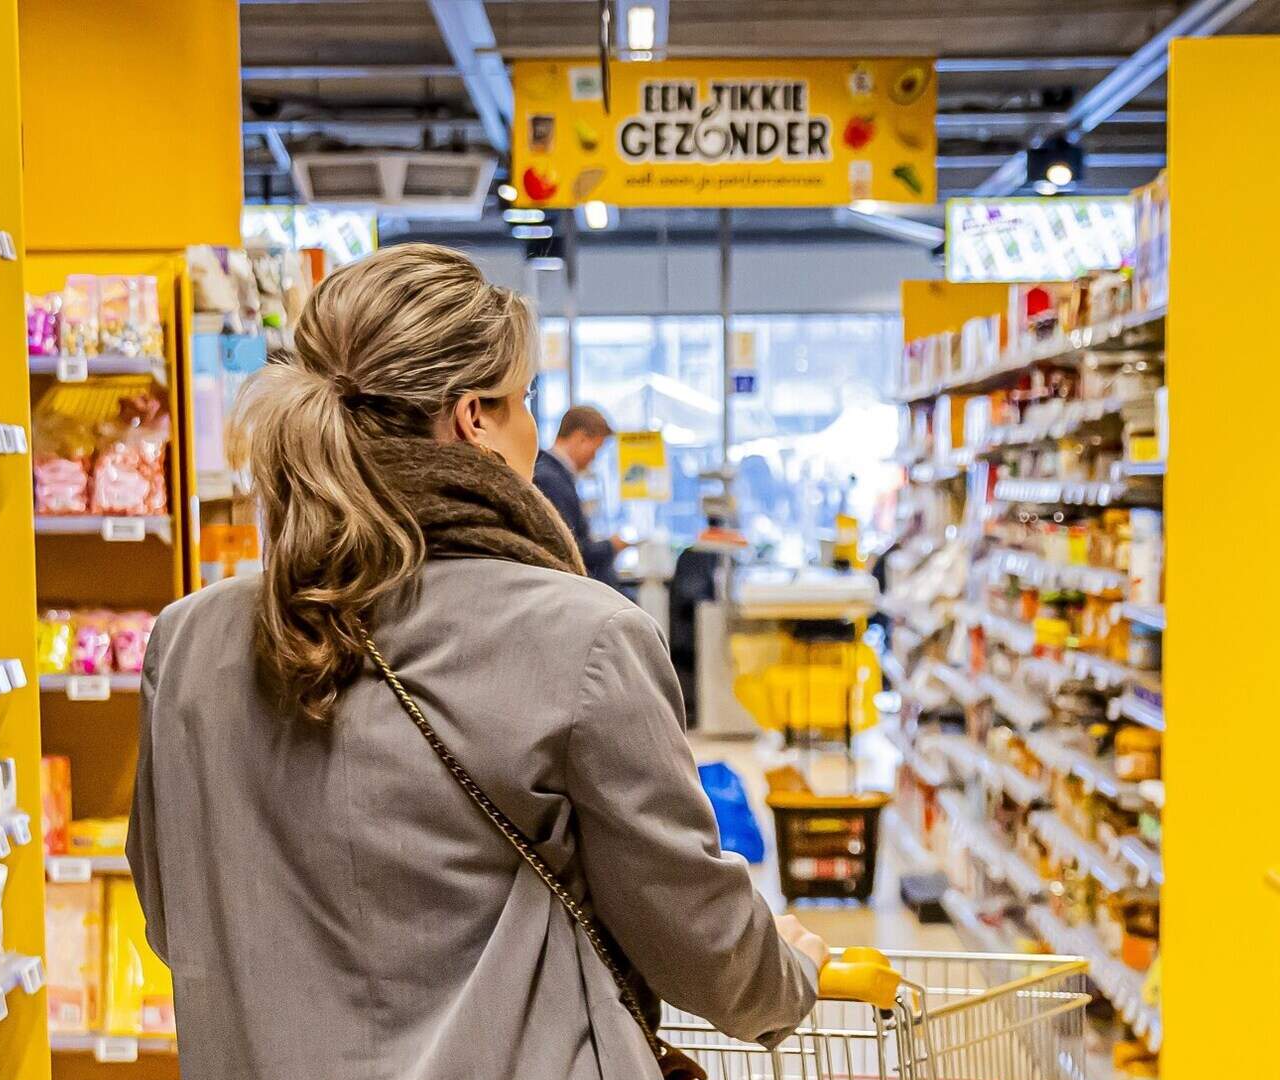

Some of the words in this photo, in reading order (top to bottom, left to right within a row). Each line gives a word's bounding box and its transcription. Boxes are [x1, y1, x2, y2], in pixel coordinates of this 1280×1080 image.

[645, 83, 696, 113] EEN
[712, 83, 806, 113] TIKKIE
[620, 119, 829, 160] GEZONDER
